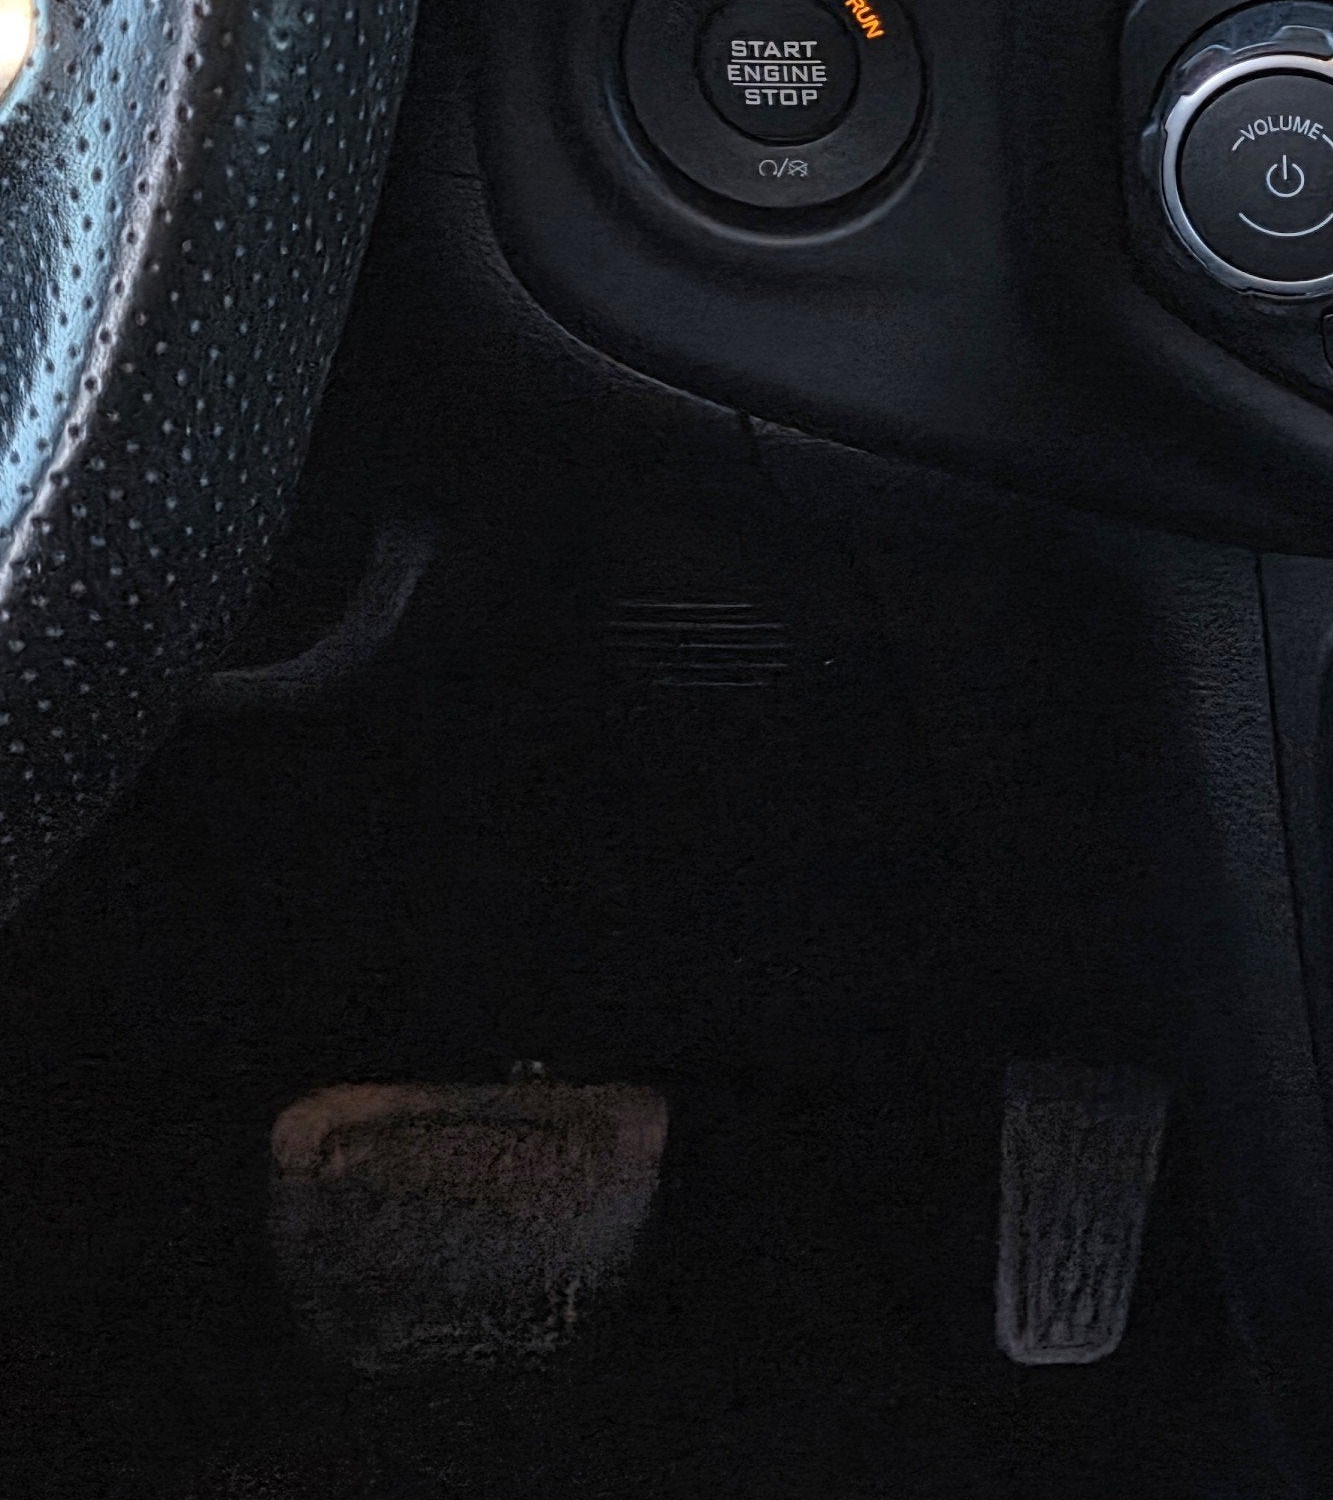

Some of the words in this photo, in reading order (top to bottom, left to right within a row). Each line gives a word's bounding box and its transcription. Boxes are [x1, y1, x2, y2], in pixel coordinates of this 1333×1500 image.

[731, 40, 818, 58] START
[726, 63, 828, 82] ENGINE
[744, 88, 818, 106] STOP
[1240, 115, 1323, 142] VOLUME
